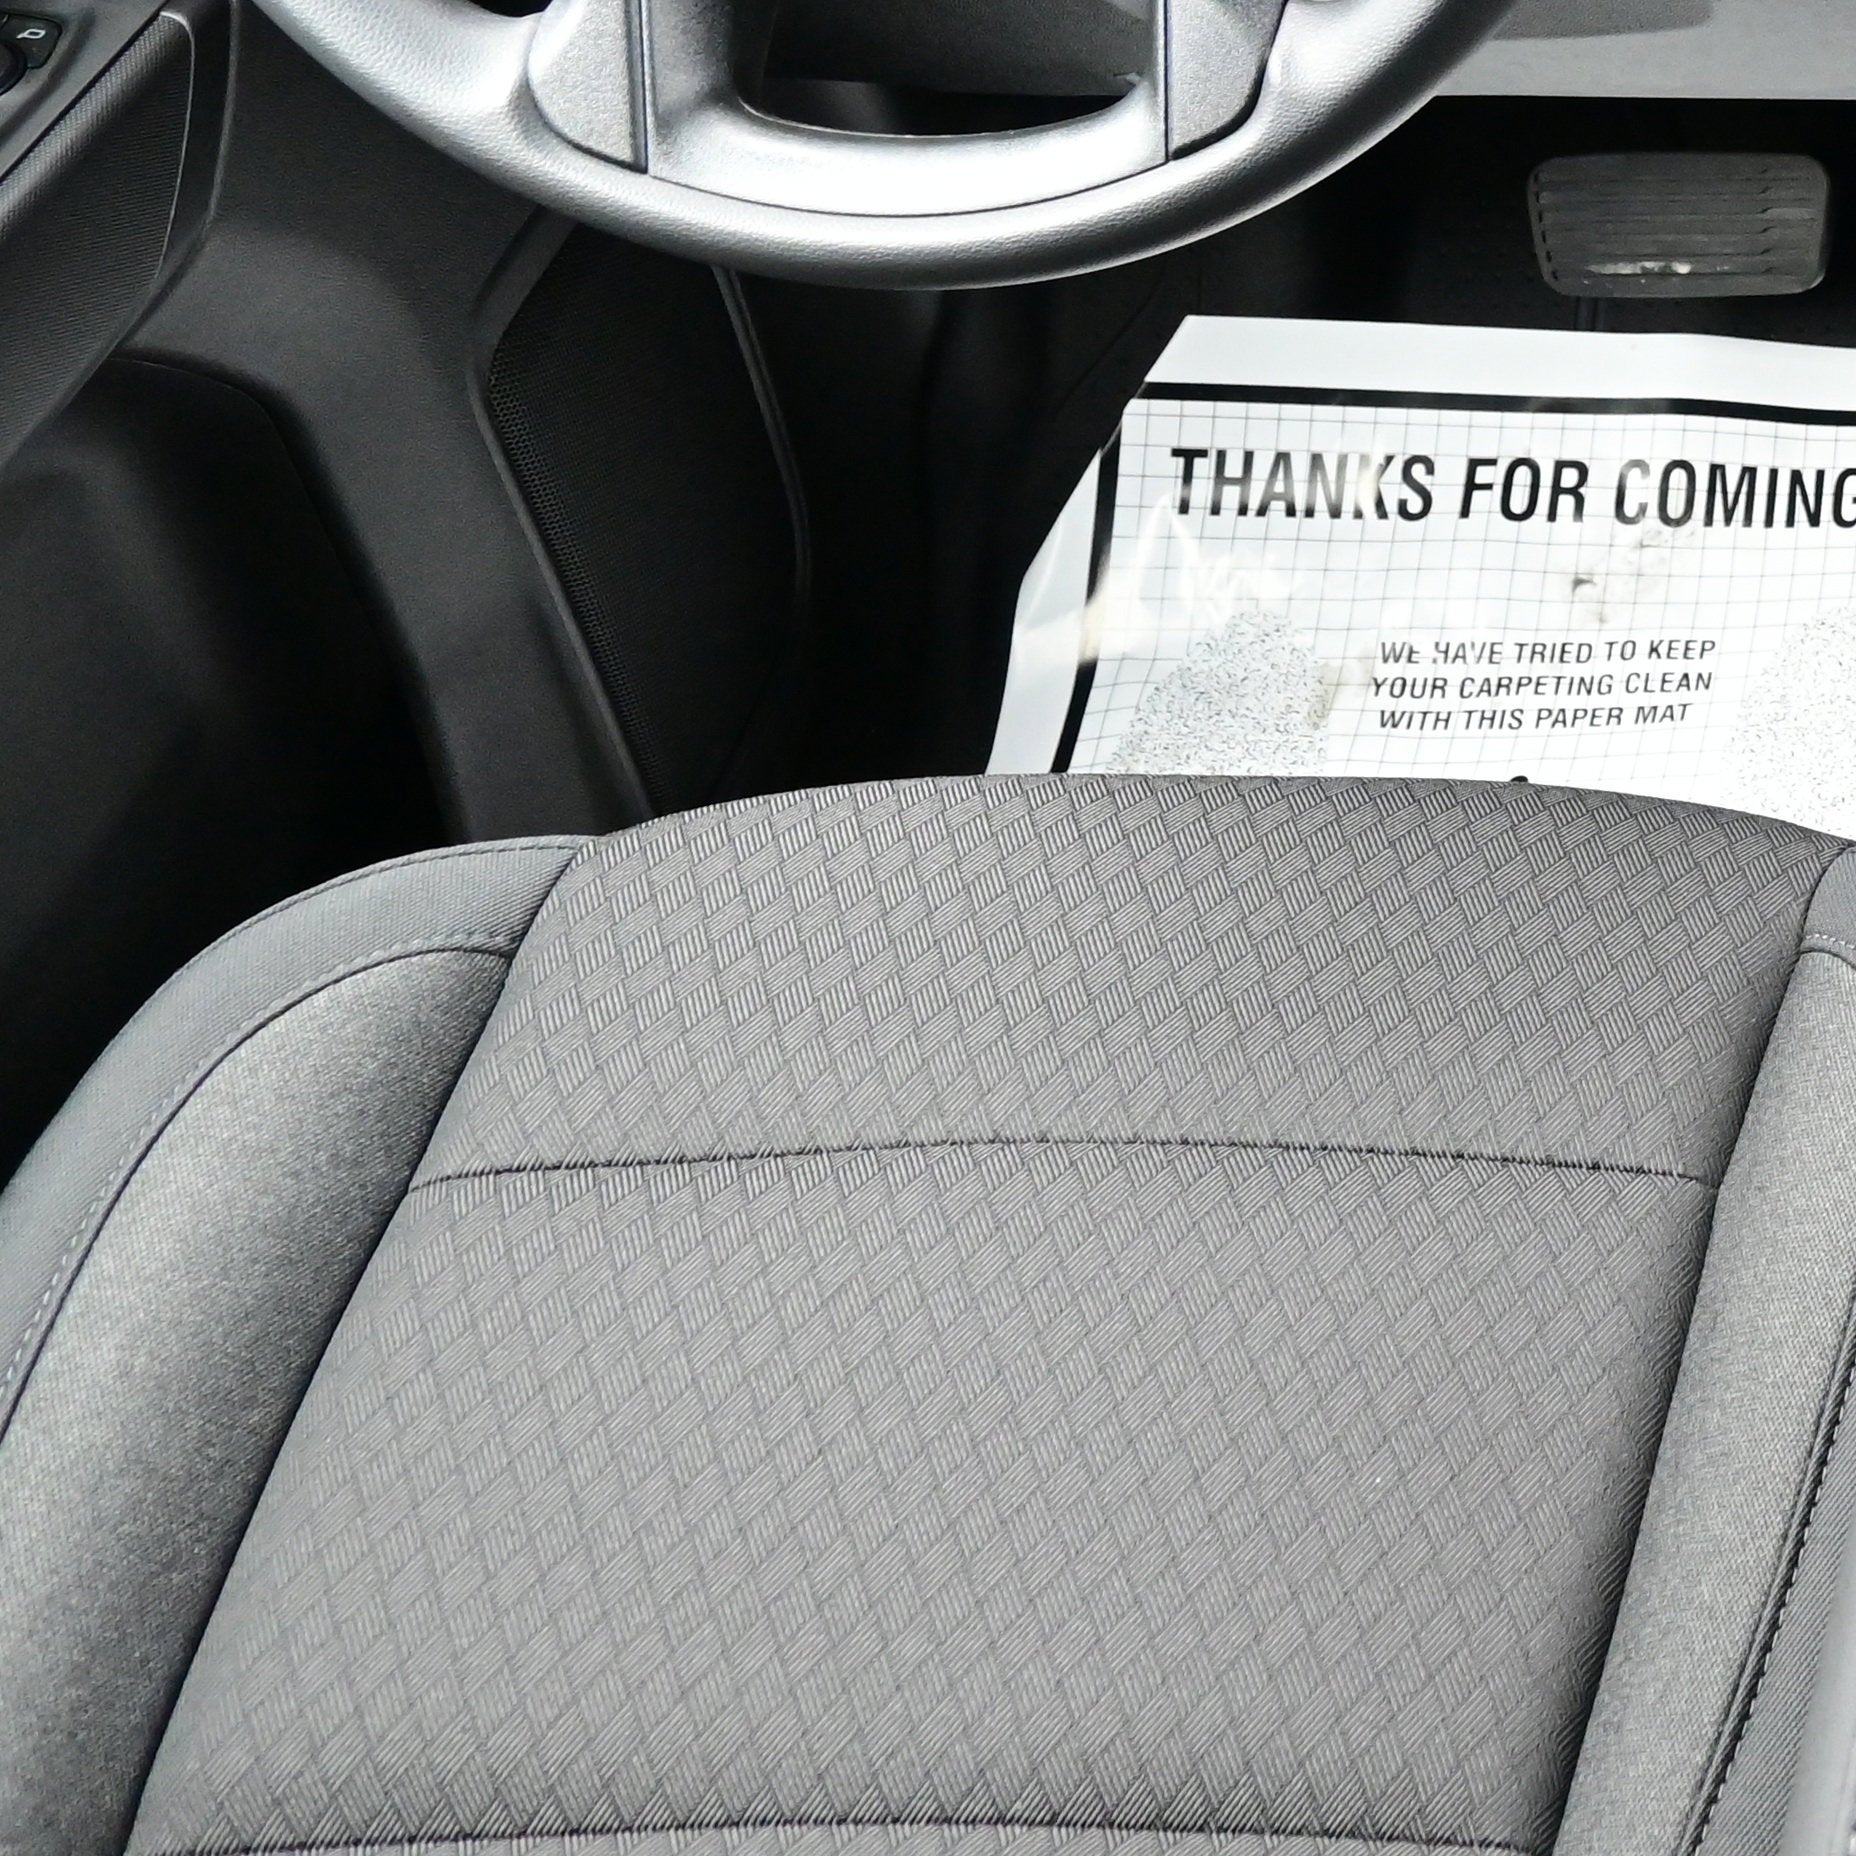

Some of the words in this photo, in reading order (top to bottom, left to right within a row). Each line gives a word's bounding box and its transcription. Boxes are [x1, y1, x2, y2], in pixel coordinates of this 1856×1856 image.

[1171, 447, 1436, 522] THANKS
[1458, 456, 1590, 523] FOR
[1380, 641, 1421, 665] WE
[1513, 642, 1594, 665] TRIED
[1605, 640, 1638, 662] TO
[1648, 639, 1717, 660] KEEP
[1371, 676, 1448, 700] YOUR
[1459, 673, 1615, 700] CARPETING
[1625, 671, 1713, 694] CLEAN
[1379, 709, 1452, 732] WITH
[1463, 708, 1526, 731] THIS
[1534, 706, 1625, 730] PAPER
[1633, 702, 1694, 726] MAT
